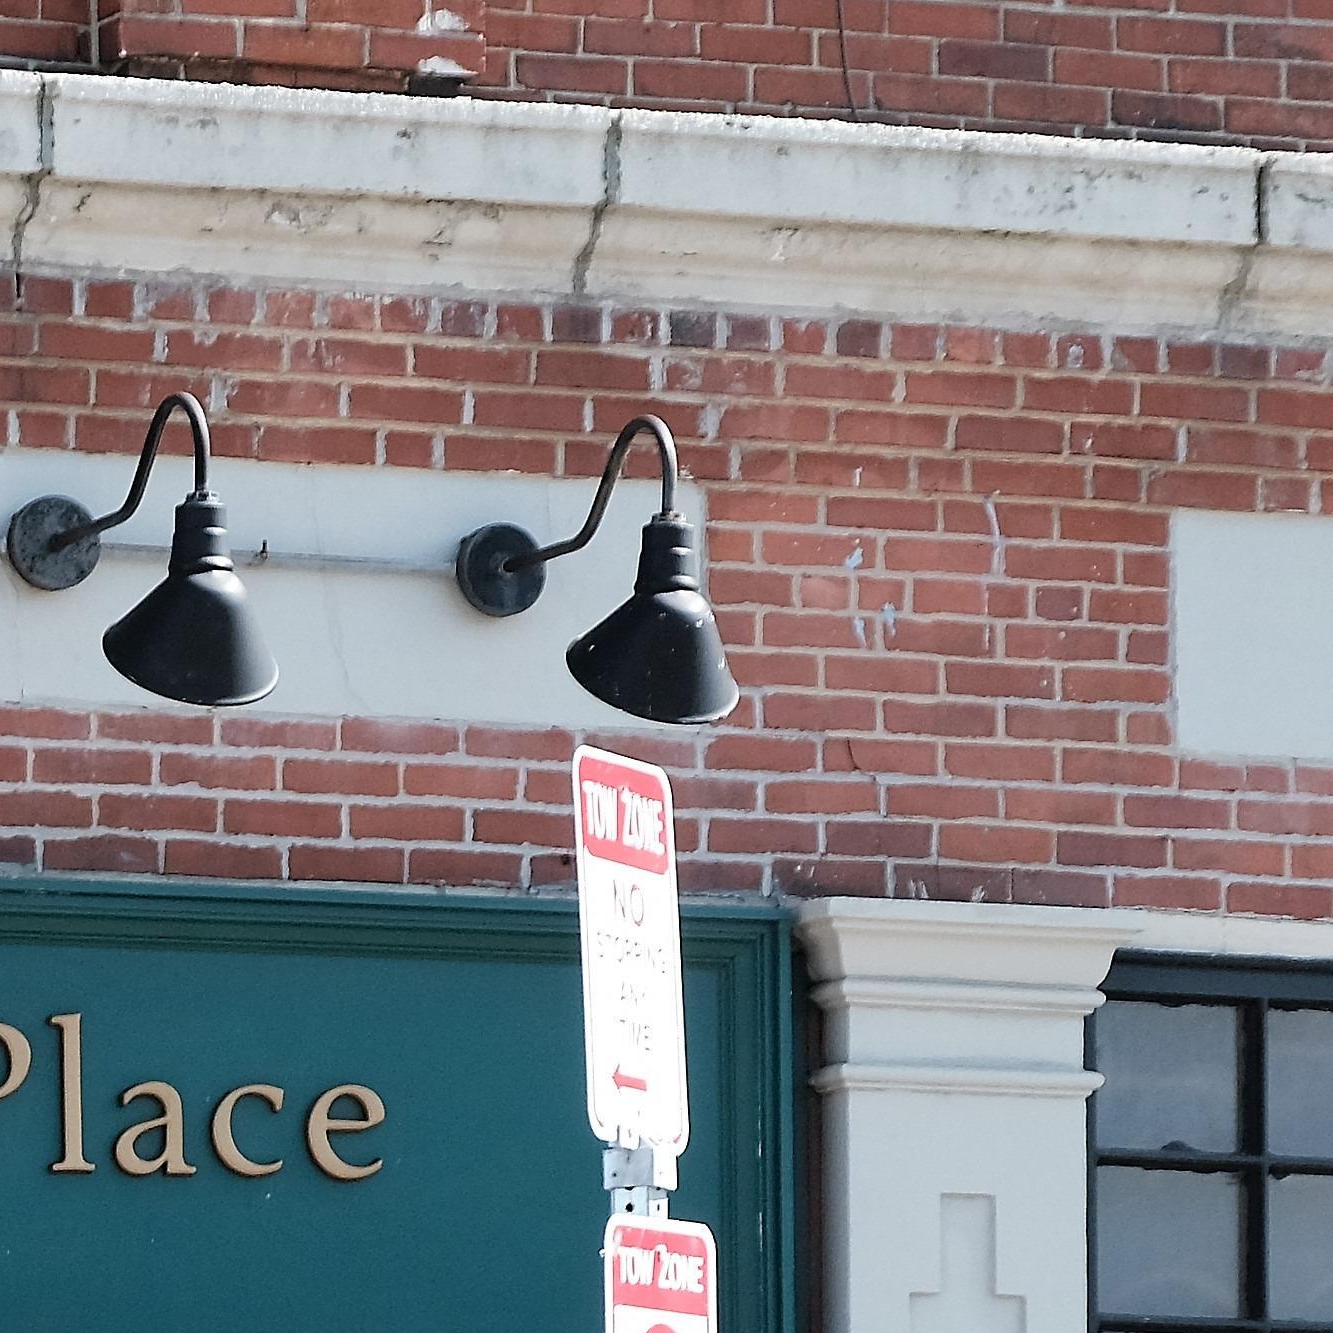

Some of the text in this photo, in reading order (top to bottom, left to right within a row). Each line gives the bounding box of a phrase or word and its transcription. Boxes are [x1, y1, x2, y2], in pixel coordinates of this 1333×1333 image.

[582, 780, 666, 856] TOW ZONE
[612, 879, 645, 927] NO
[616, 1243, 705, 1294] TOW ZONE
